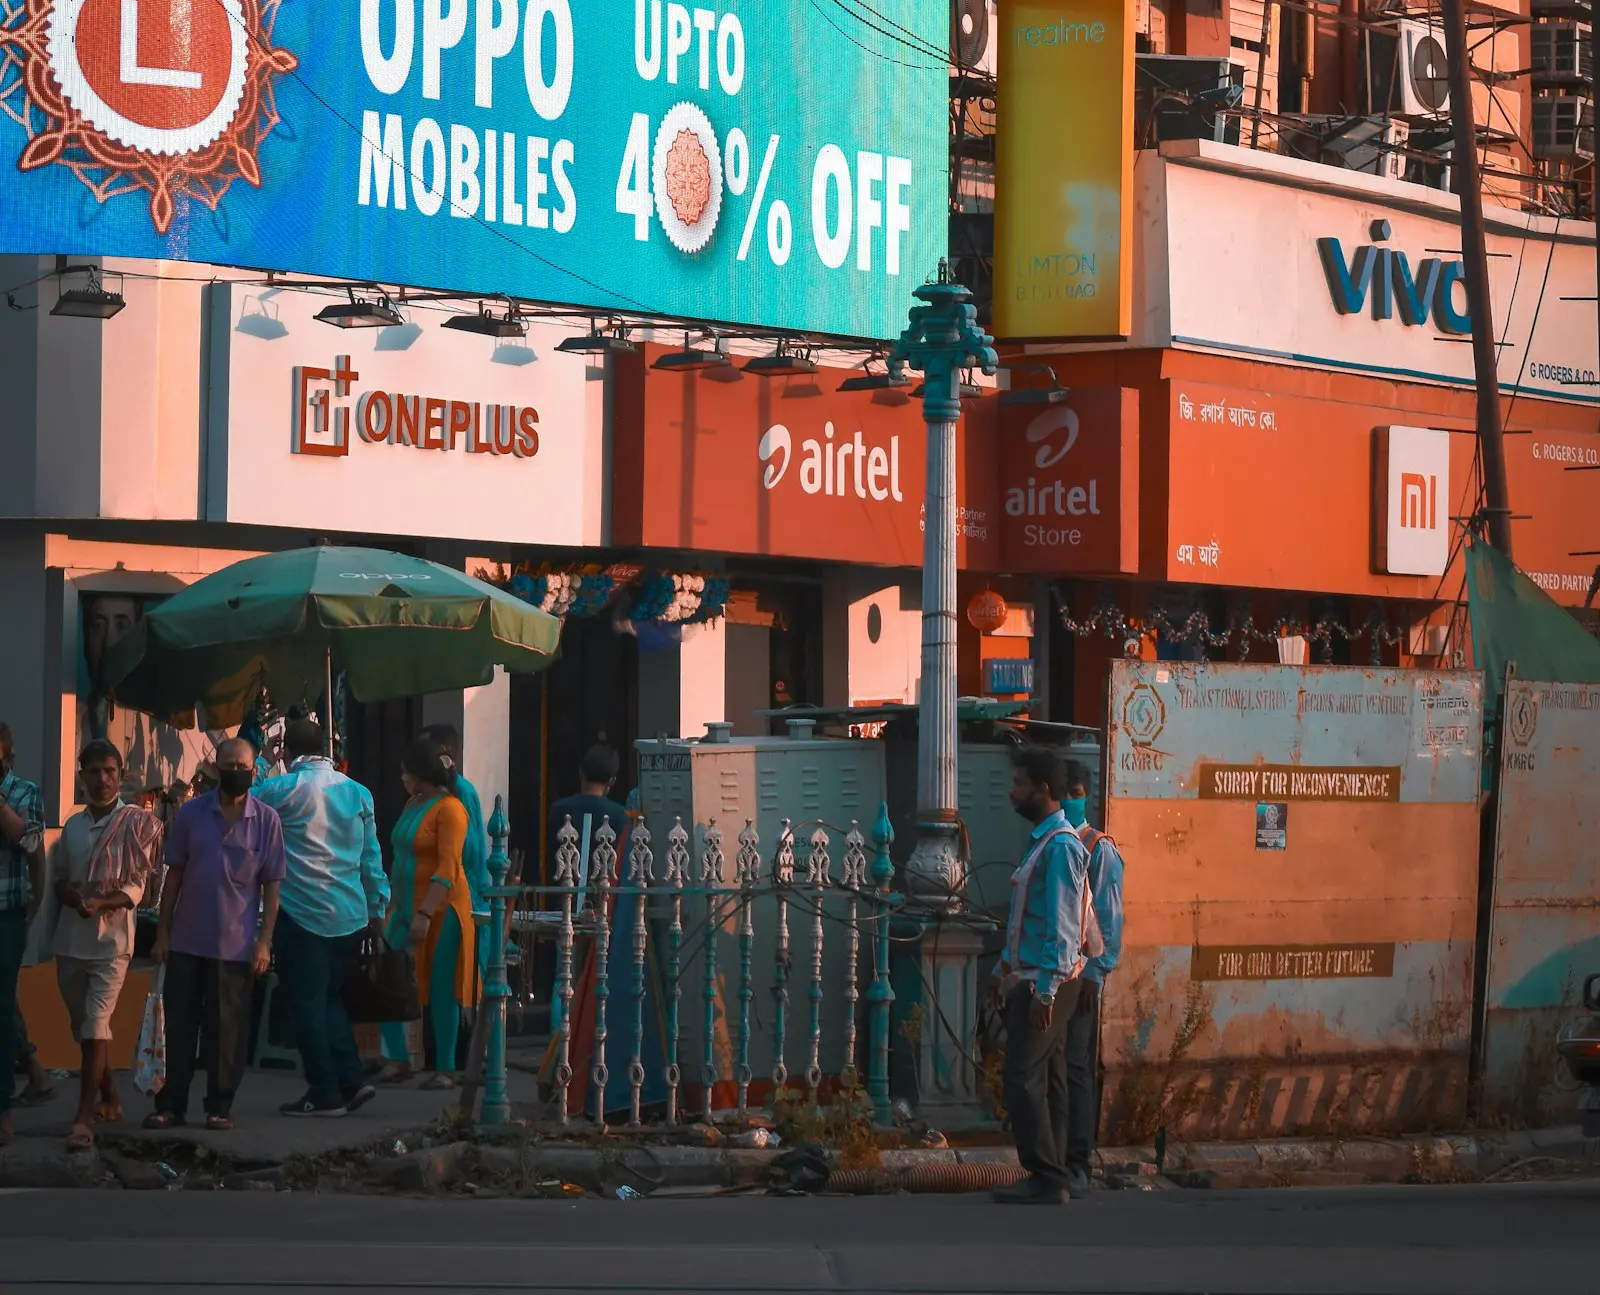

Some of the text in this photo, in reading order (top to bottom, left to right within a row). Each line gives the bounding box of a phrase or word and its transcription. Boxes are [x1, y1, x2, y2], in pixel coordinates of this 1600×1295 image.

[1017, 17, 1105, 47] realme
[358, 110, 577, 233] MOBILES
[811, 144, 912, 275] OFF
[1017, 252, 1096, 277] LIMTON
[1529, 362, 1536, 378] G
[1538, 363, 1573, 383] ROGERS
[355, 390, 540, 458] ONEPLUS
[799, 421, 903, 503] airtel
[1532, 442, 1599, 465] G. ROGERS & CO.
[1005, 477, 1100, 516] airtel
[960, 506, 986, 522] Partner
[1024, 524, 1082, 546] Store
[993, 664, 1033, 689] SAMSUNG
[1121, 752, 1163, 772] KMRC
[1507, 751, 1536, 772] KMRC
[1214, 770, 1390, 797] SORRY FOR INCONVENIENCE
[1218, 949, 1375, 977] FOR OUR BETTER FUTURE
